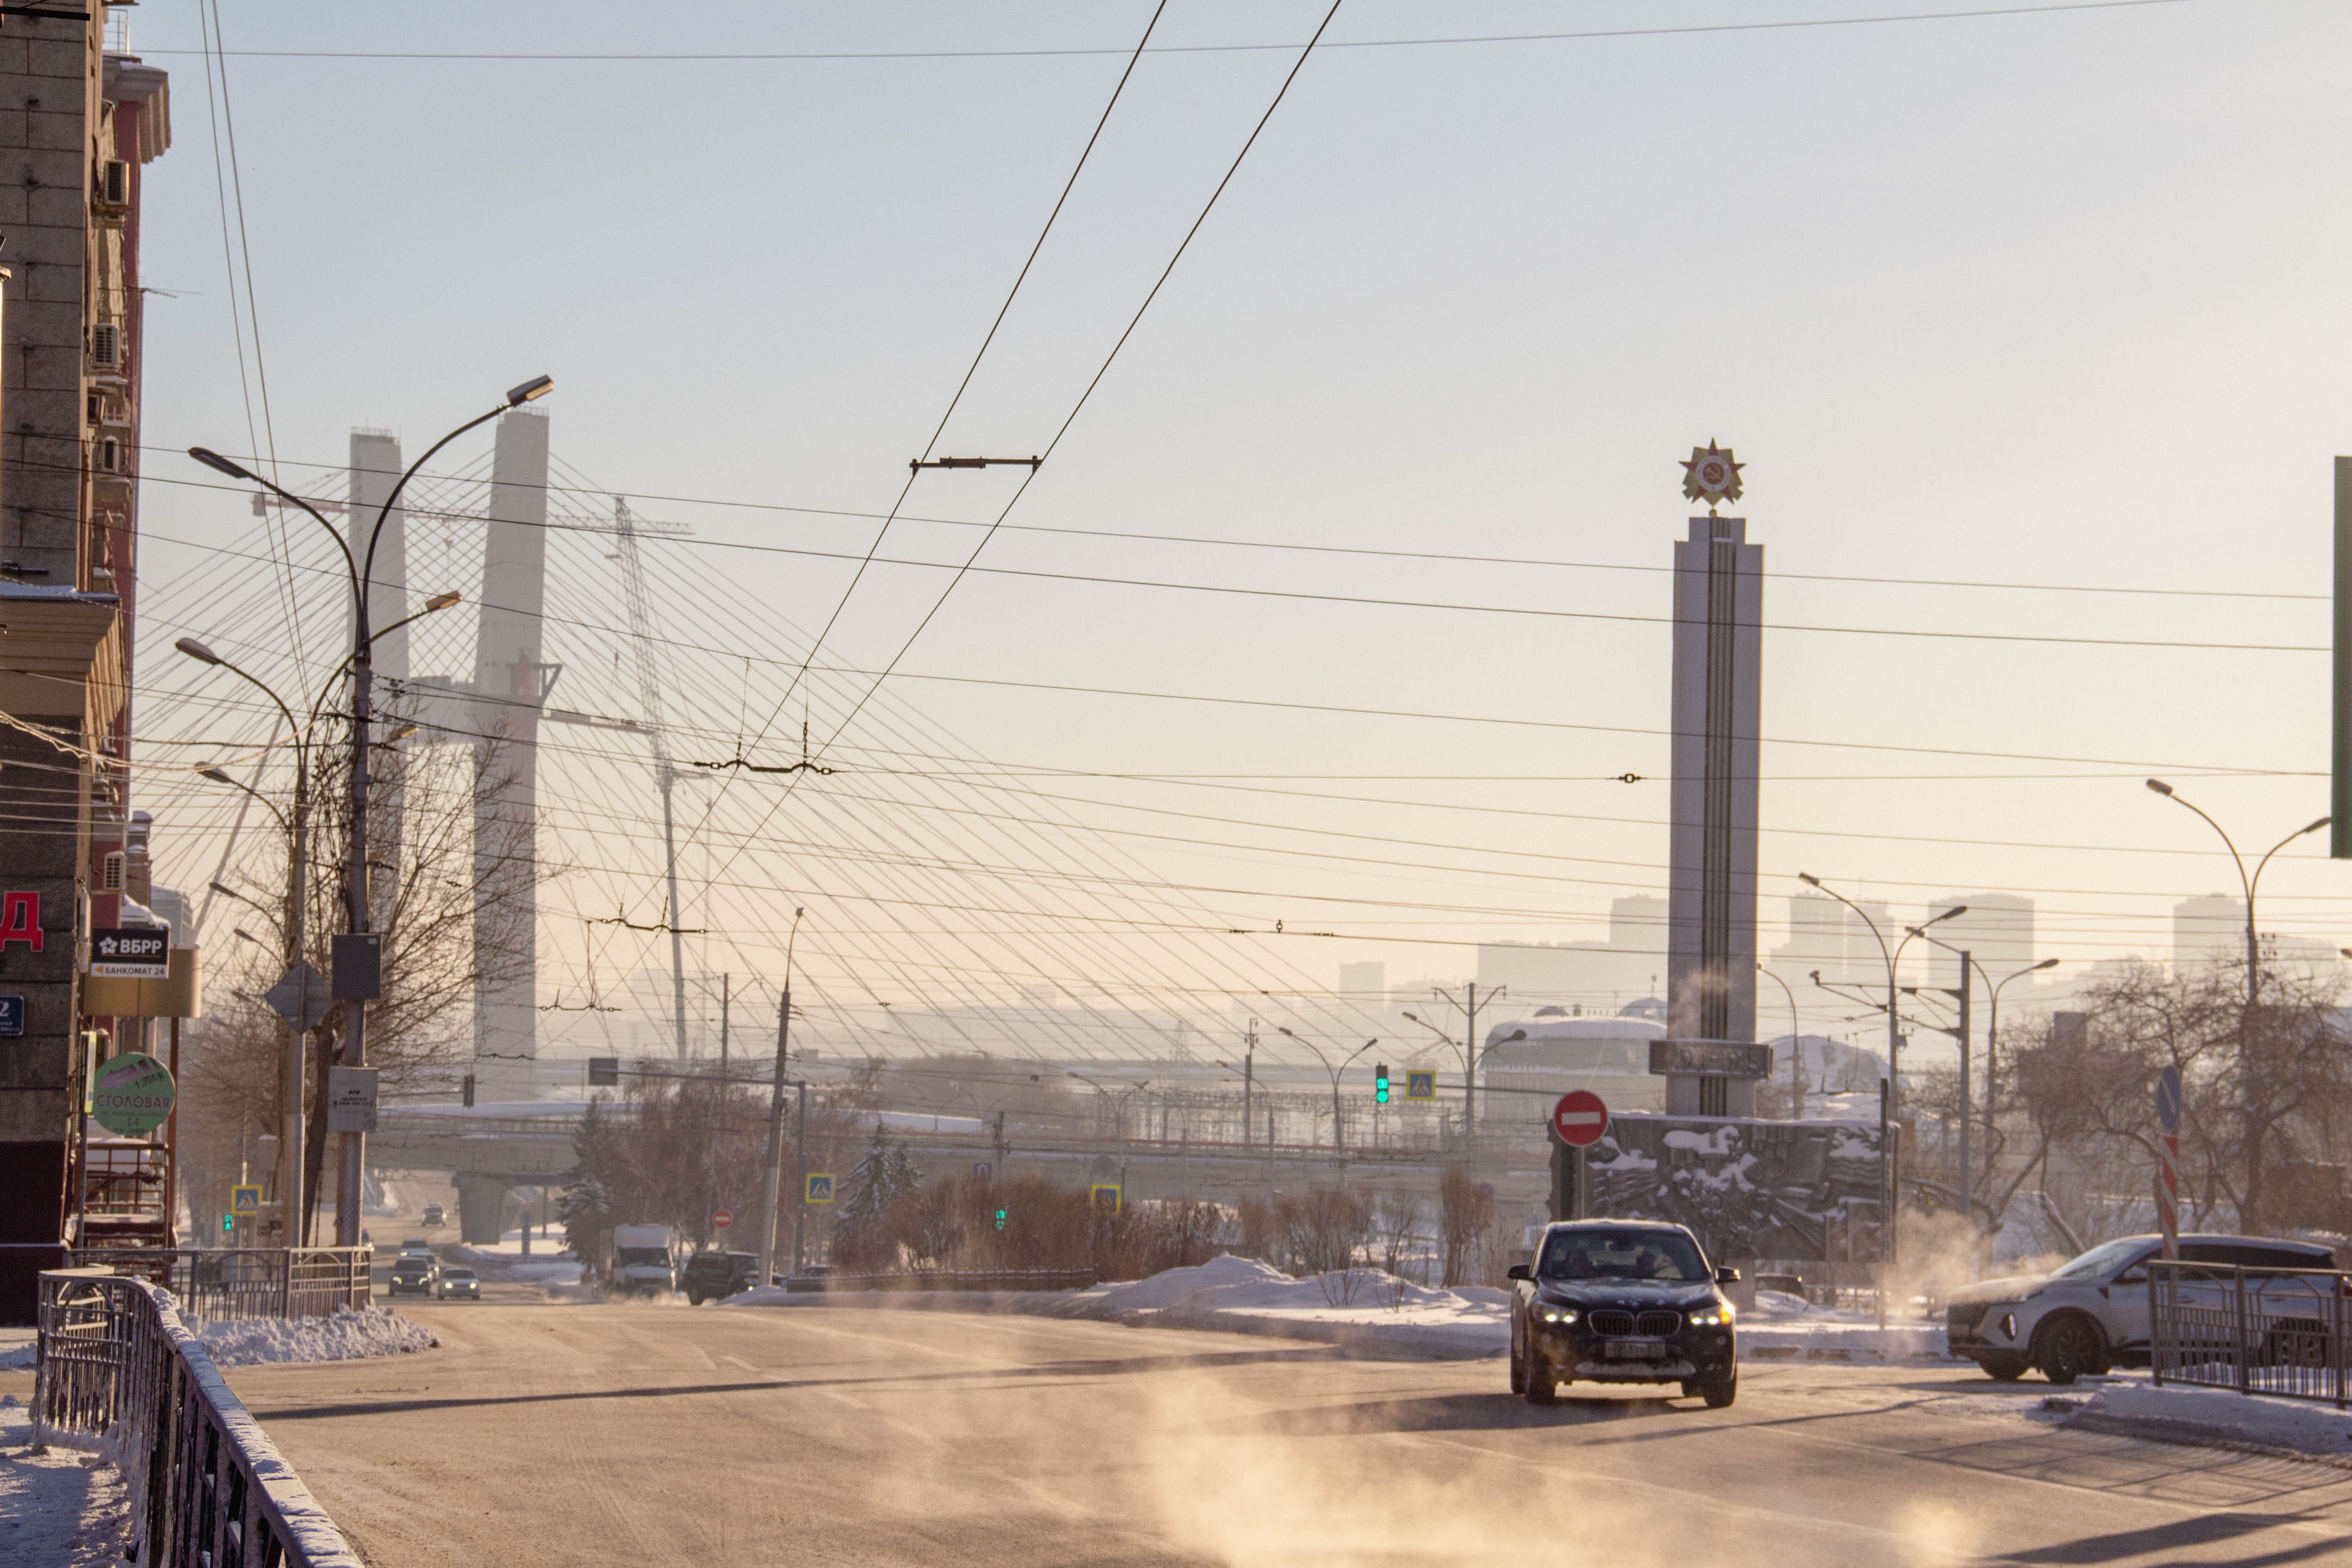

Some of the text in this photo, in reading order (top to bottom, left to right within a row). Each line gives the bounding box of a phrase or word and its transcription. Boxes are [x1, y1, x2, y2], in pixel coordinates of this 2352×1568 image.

[0, 891, 44, 952] Д
[120, 939, 162, 954] ВБРР
[105, 966, 152, 975] БАНКОМАТ
[142, 1071, 164, 1087] ЭТАЖ
[96, 1094, 170, 1109] СТОЛОВАЯ
